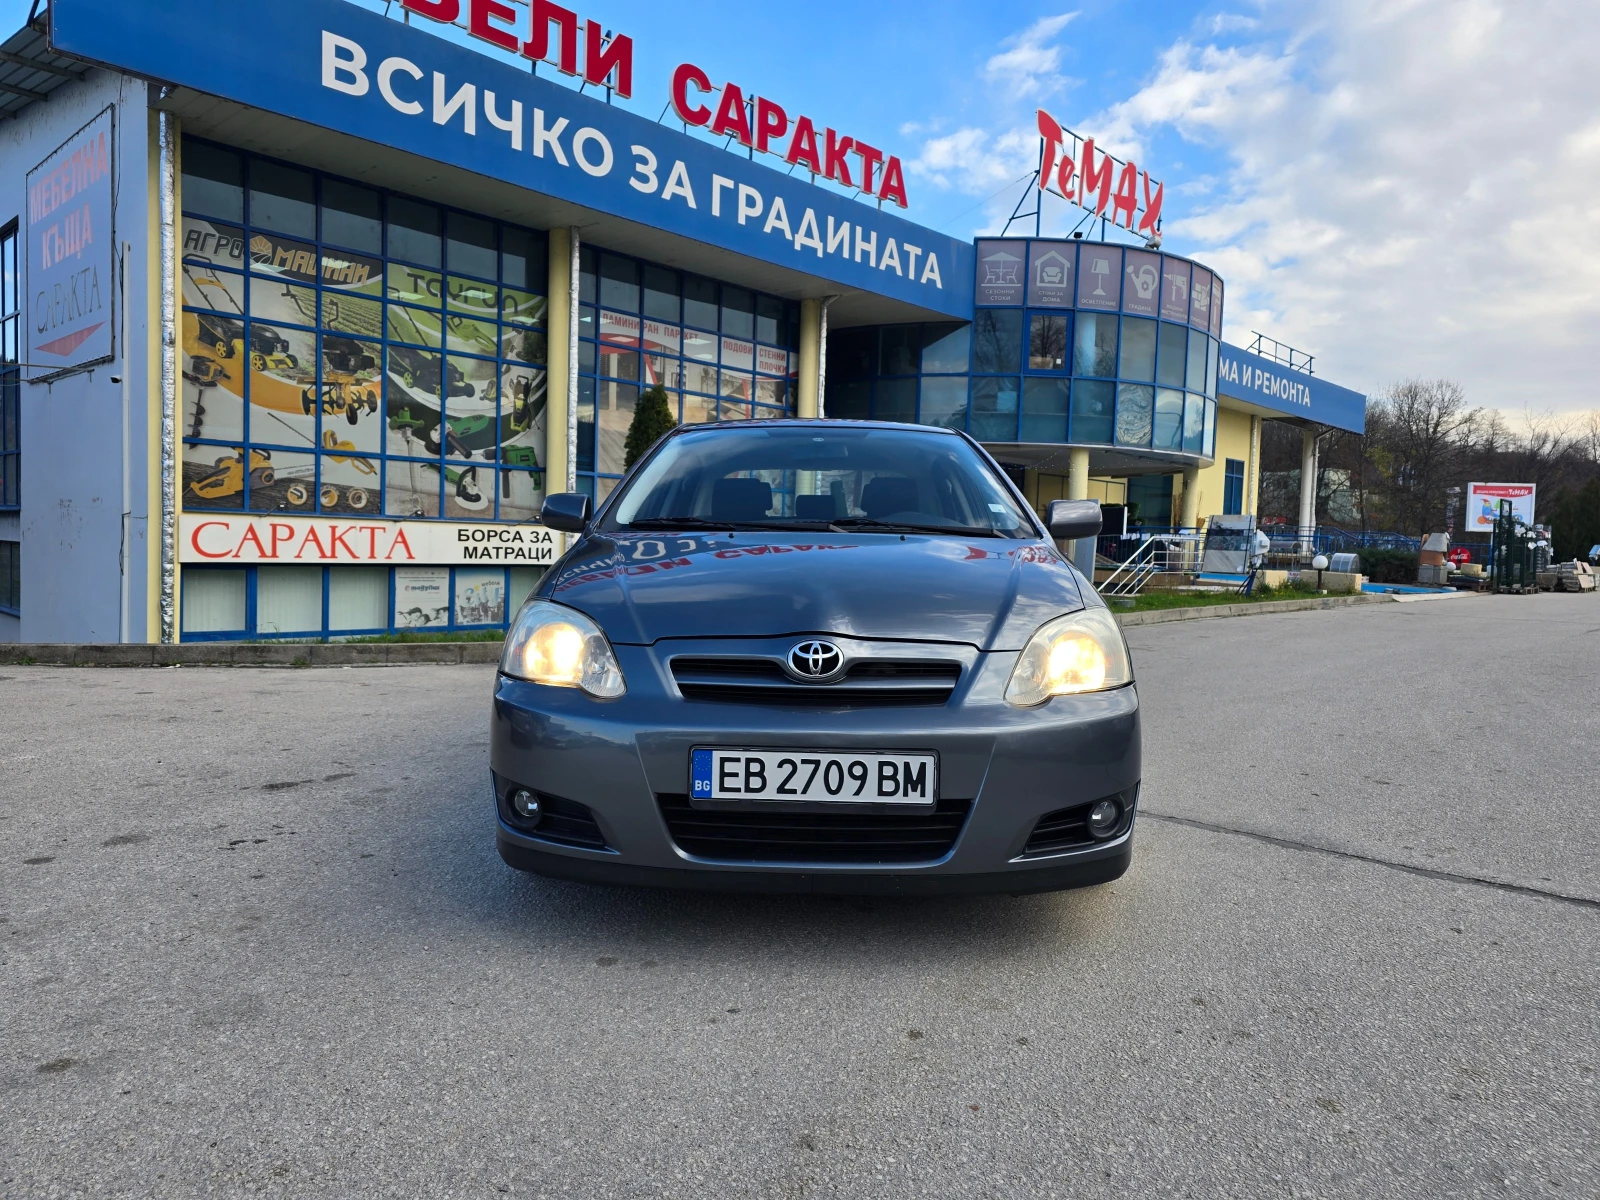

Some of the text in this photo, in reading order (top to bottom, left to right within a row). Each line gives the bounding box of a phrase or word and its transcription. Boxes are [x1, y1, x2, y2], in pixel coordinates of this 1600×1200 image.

[399, 0, 908, 209] ЕЛИ САРАКТА
[321, 30, 943, 289] ВСИЧКО ЗА ГРАДИНАТА
[30, 131, 108, 225] МЕБЕЛНА
[41, 202, 93, 270] КЪЩА
[184, 229, 245, 260] АГРО
[36, 264, 102, 334] САРАКТА
[1081, 298, 1117, 307] ОСВЕТЛЕНИЕ
[1128, 303, 1152, 312] ГРАДИНА
[602, 313, 699, 341] ЛАМИНИРАН ПАРКЕТ
[723, 340, 786, 361] ПОДОВИ СТЕННИ
[759, 361, 787, 374] ПЛОЧКИ
[1219, 356, 1311, 407] МА И РЕМОНТА
[191, 521, 415, 560] САРАКТА
[457, 529, 553, 544] БОРСА ЗА
[463, 546, 553, 562] МАТРАЦИ
[694, 779, 711, 791] BG
[718, 757, 926, 798] EB 2709 BM
